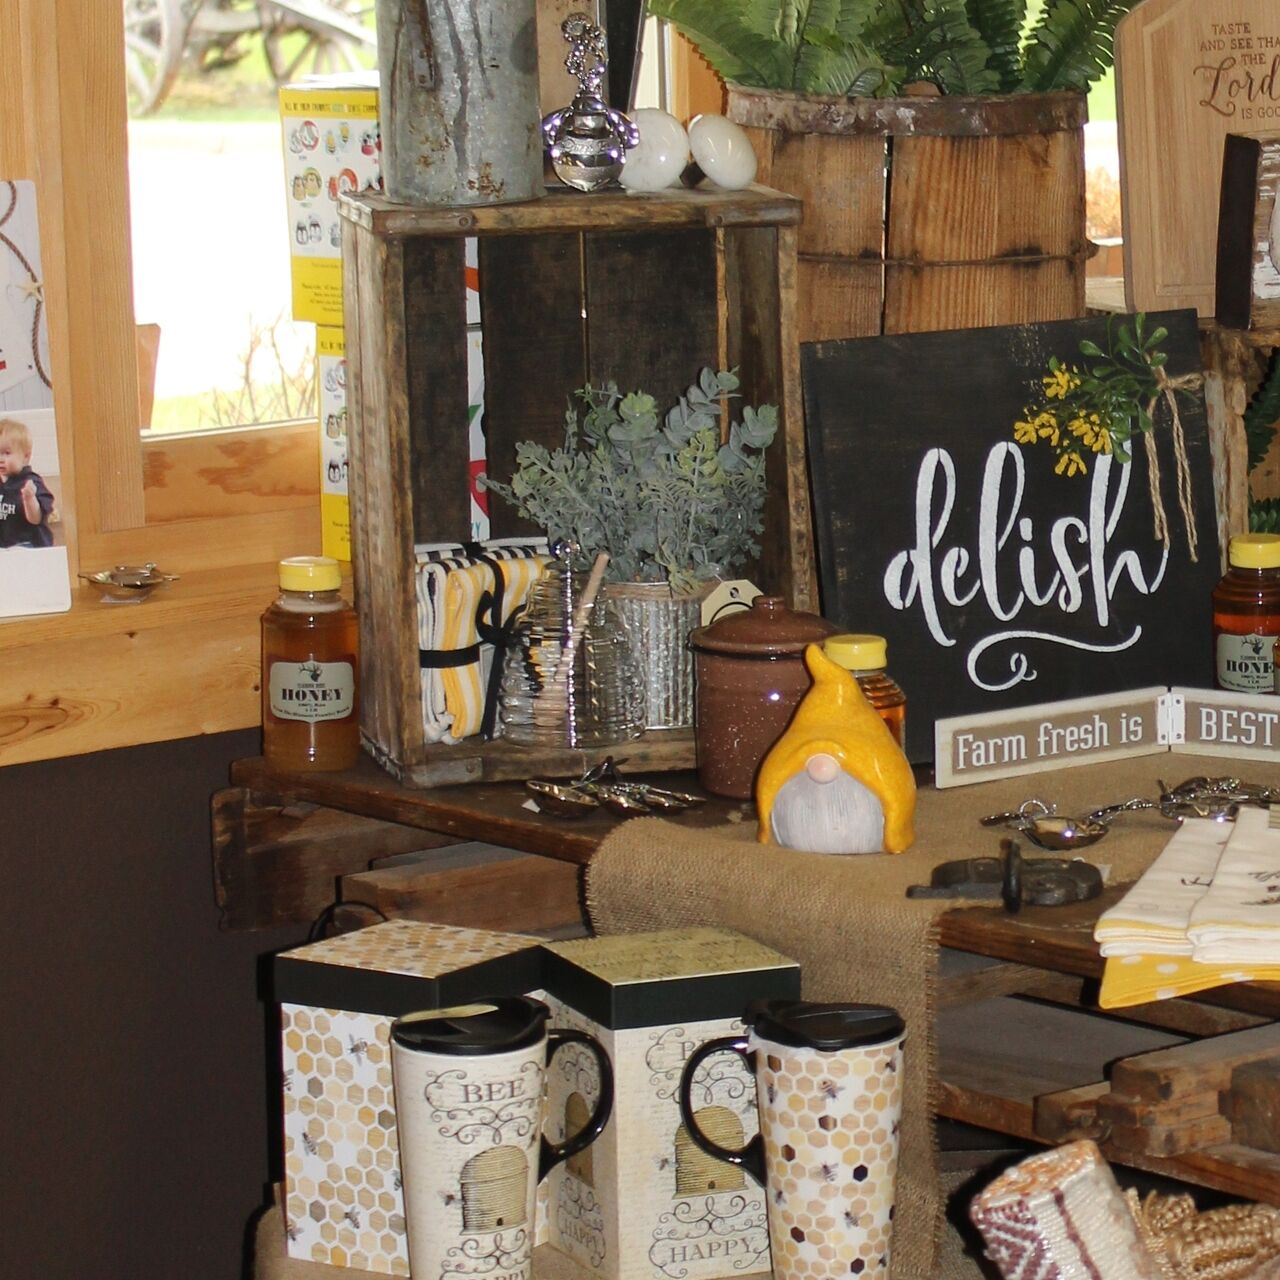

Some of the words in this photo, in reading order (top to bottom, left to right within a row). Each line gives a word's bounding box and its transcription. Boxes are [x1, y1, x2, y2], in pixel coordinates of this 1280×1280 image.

[1211, 23, 1251, 36] TASTE
[1200, 39, 1225, 52] AND
[1230, 37, 1253, 50] SEE
[1241, 53, 1266, 65] THE
[1241, 108, 1253, 120] IS
[884, 418, 1169, 647] delish
[282, 687, 343, 701] HONEY
[1200, 707, 1279, 746] BEST
[957, 734, 1028, 770] Farm
[1037, 715, 1110, 758] fresh
[1120, 713, 1143, 744] is
[462, 1078, 527, 1104] BEE
[668, 1237, 755, 1264] HAPPY
